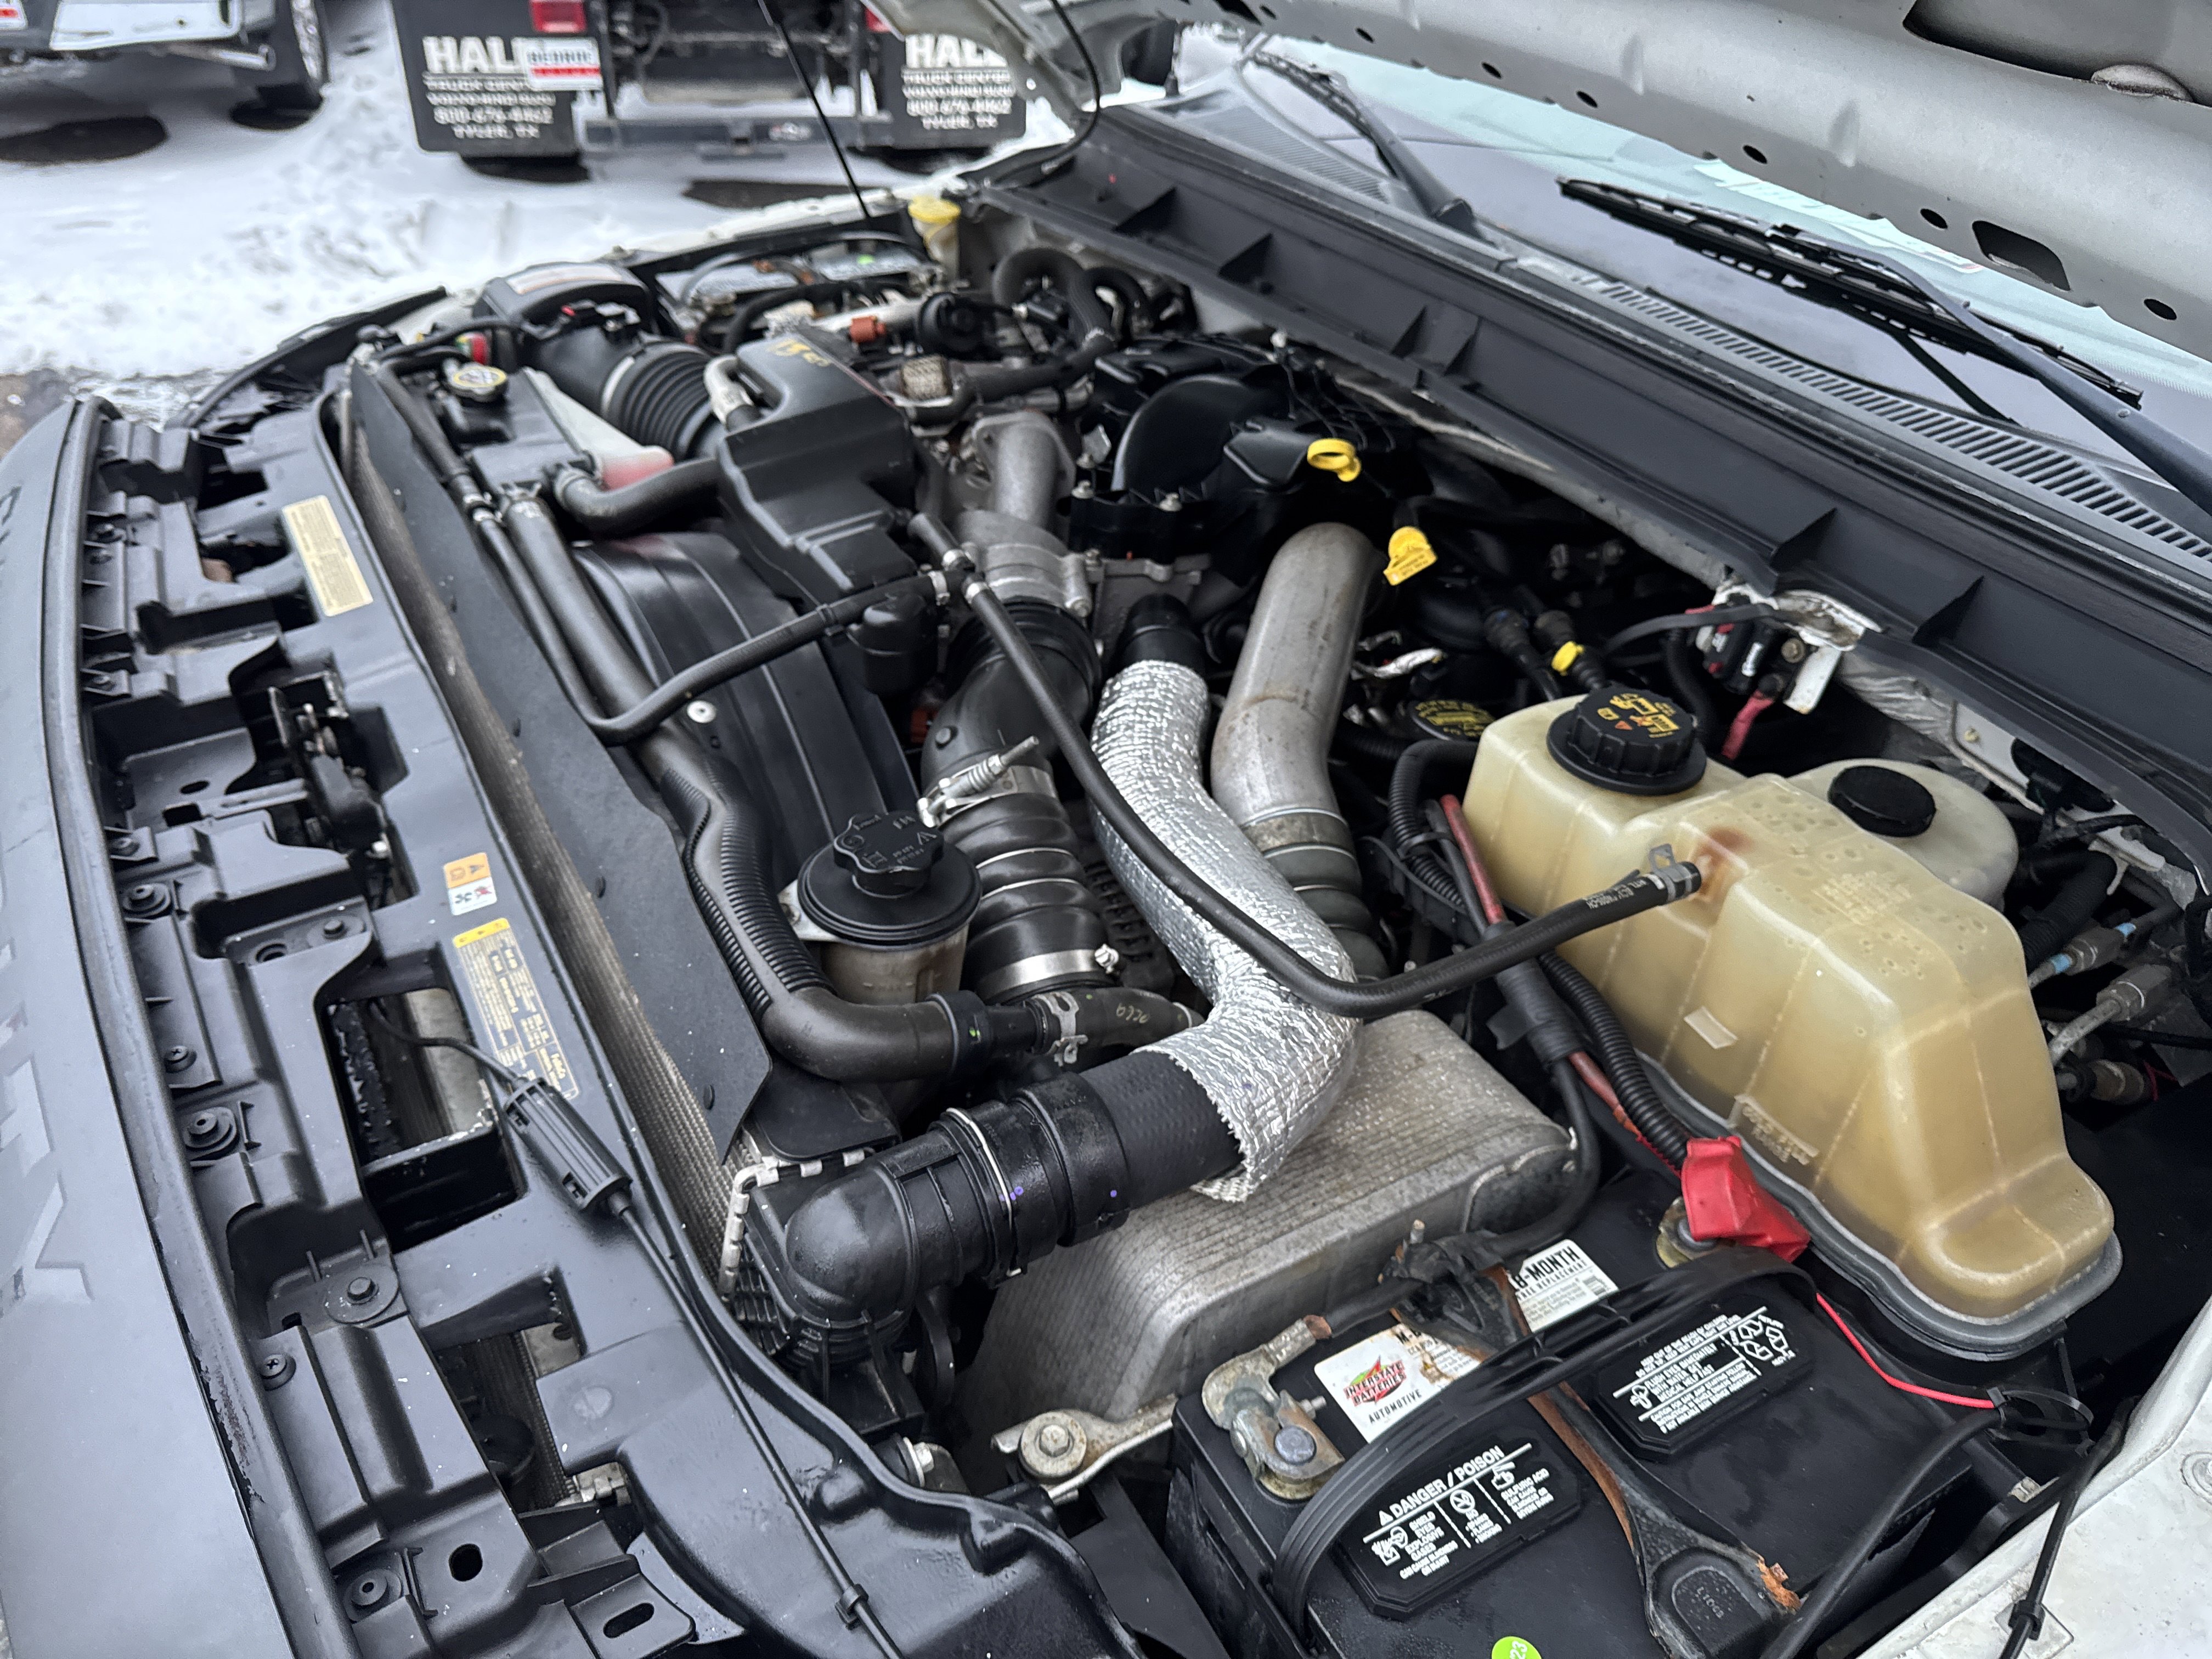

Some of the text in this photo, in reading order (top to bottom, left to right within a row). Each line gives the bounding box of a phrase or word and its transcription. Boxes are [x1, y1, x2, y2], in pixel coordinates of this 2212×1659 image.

[1512, 1246, 1581, 1291] 8-MONTH
[1536, 1260, 1587, 1289] REPLACEMENT
[1344, 1360, 1405, 1399] INTERSTATE
[1352, 1372, 1407, 1406] BATTERIES
[1368, 1389, 1421, 1424] AUTOMOTIVE
[1390, 1479, 1447, 1519] DANGER
[1454, 1446, 1505, 1481] POISON
[1501, 1468, 1550, 1500] SULFURIC ACID
[1409, 1511, 1435, 1531] SHIELD
[1414, 1522, 1437, 1538] EYES
[1403, 1527, 1444, 1554] EXPLOSIVE
[1409, 1542, 1436, 1561] GASES
